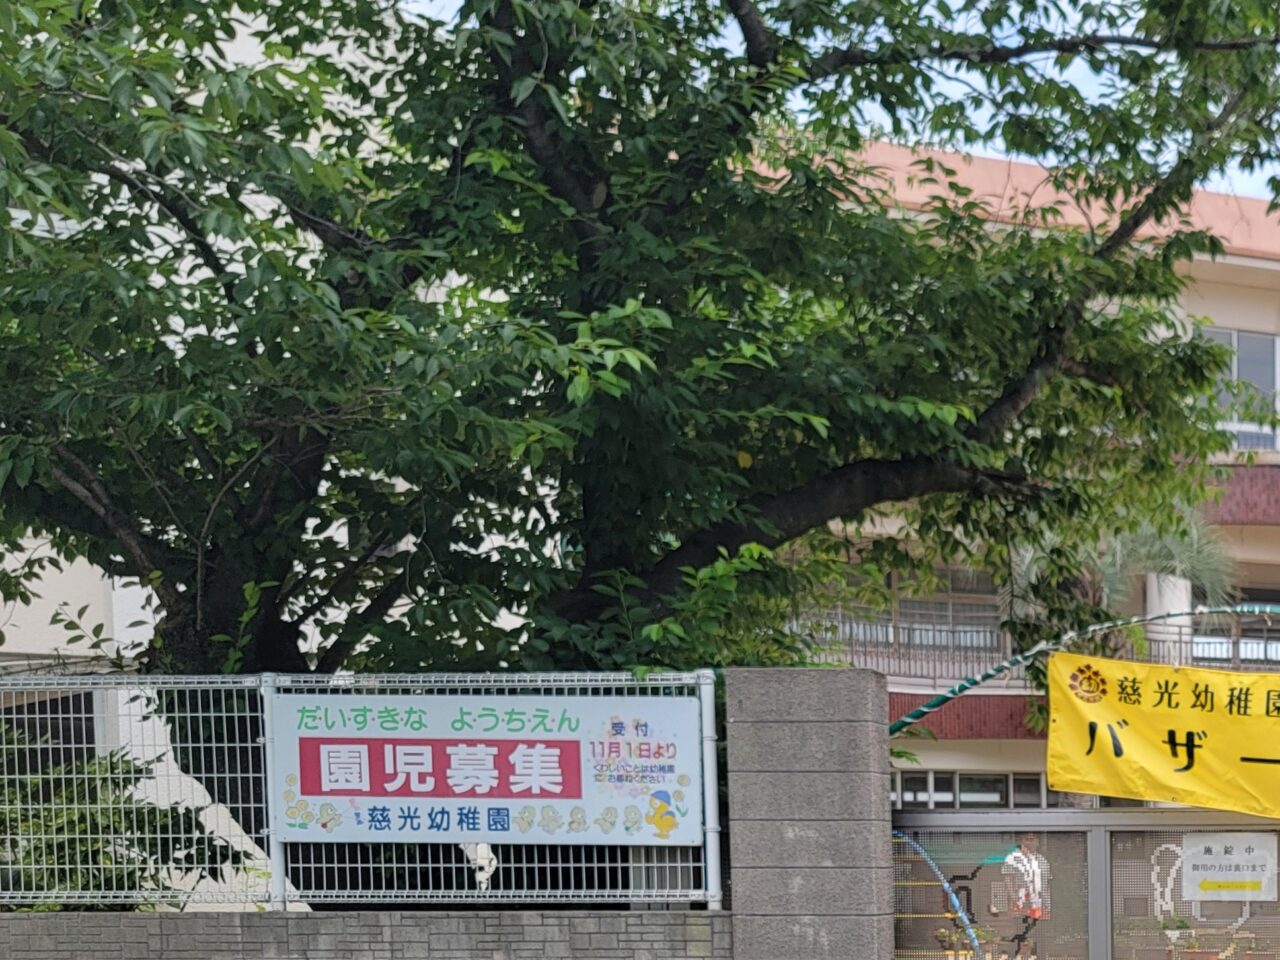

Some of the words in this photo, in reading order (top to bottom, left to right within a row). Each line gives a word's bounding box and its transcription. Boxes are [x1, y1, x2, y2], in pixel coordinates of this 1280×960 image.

[611, 721, 648, 737] 受付
[589, 741, 677, 759] 11月1日より
[319, 742, 564, 794] 園児募集
[367, 805, 511, 832] 慈光幼稚園
[1203, 844, 1254, 856] 施錠中
